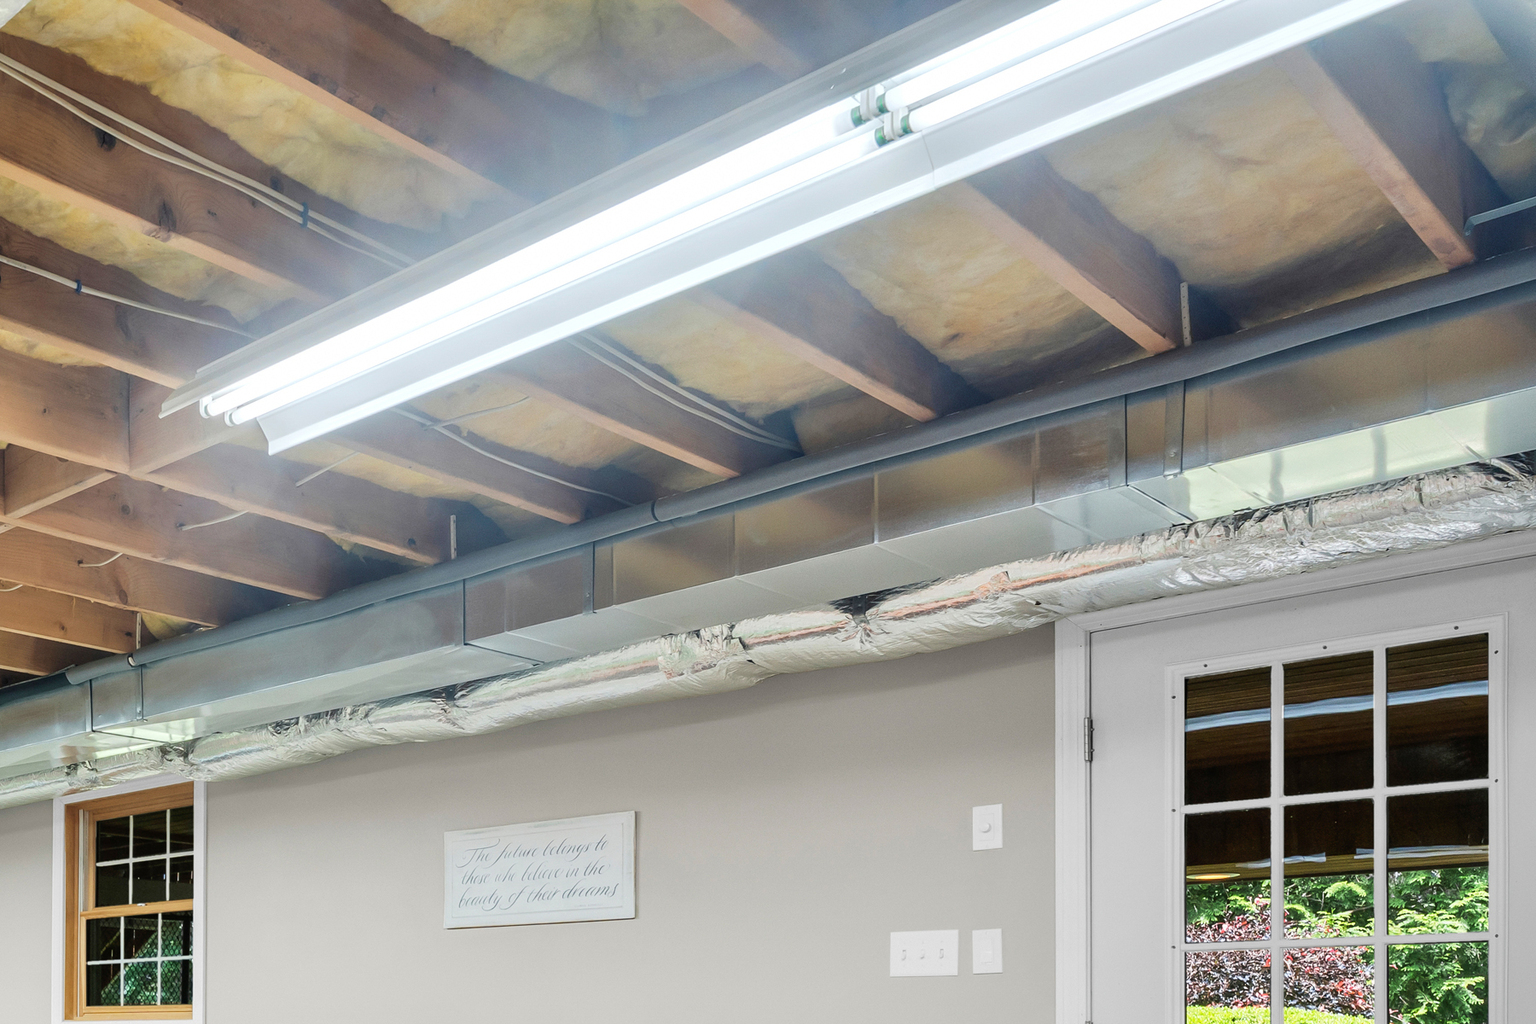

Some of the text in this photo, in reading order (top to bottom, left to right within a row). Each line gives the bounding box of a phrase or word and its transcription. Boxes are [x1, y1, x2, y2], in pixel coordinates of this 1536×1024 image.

[455, 834, 610, 869] The future belongs to
[461, 856, 611, 885] those who believe in the
[458, 878, 620, 912] beauty of their dreams
